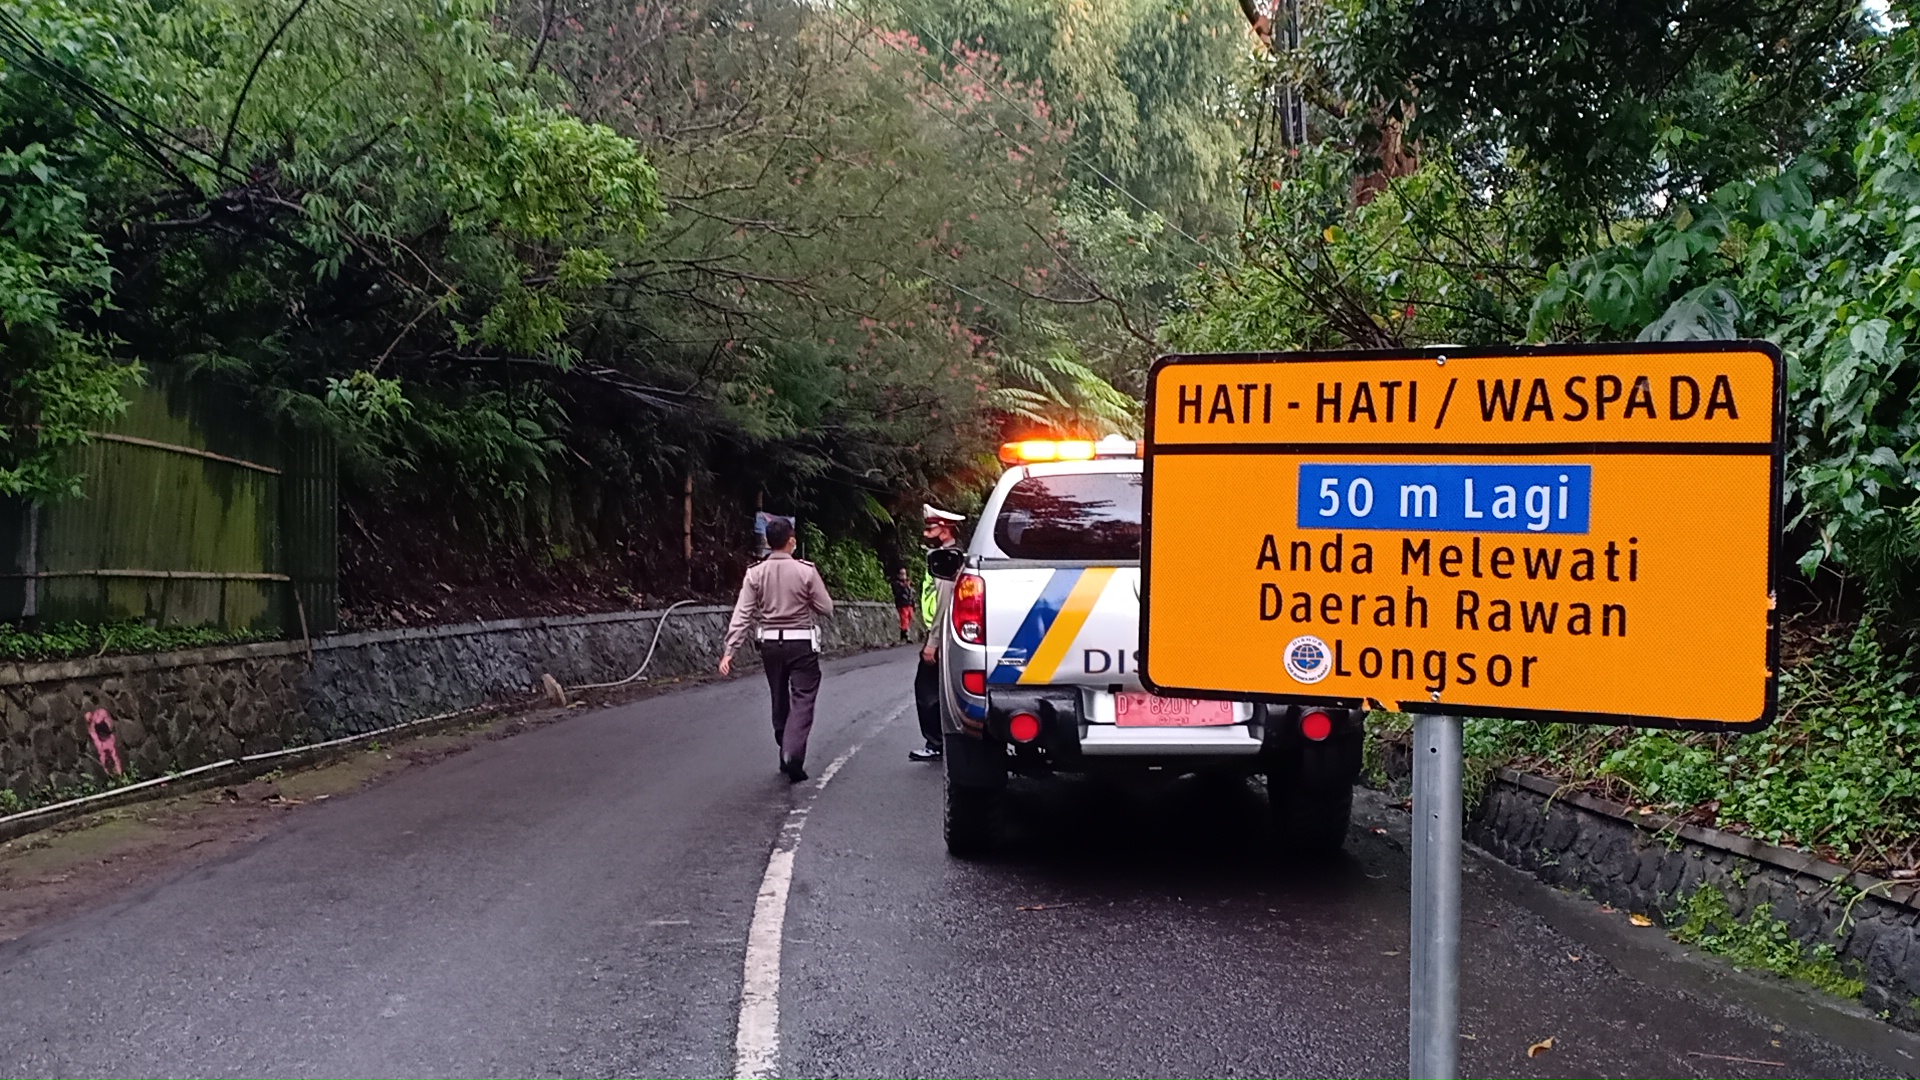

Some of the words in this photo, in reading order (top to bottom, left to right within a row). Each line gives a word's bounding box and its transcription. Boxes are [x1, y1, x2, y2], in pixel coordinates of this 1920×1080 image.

[1178, 383, 1272, 424] HATI
[1316, 380, 1417, 423] HATI
[1476, 374, 1739, 422] WASPADA
[1319, 477, 1374, 517] 50
[1400, 484, 1438, 518] m
[1464, 474, 1569, 531] Lagi
[1256, 533, 1373, 575] Anda
[1401, 536, 1638, 582] Melewati
[1259, 582, 1428, 628] Daerah
[1456, 589, 1626, 637] Rawan
[1335, 639, 1538, 694] Longsor
[1117, 695, 1129, 715] D
